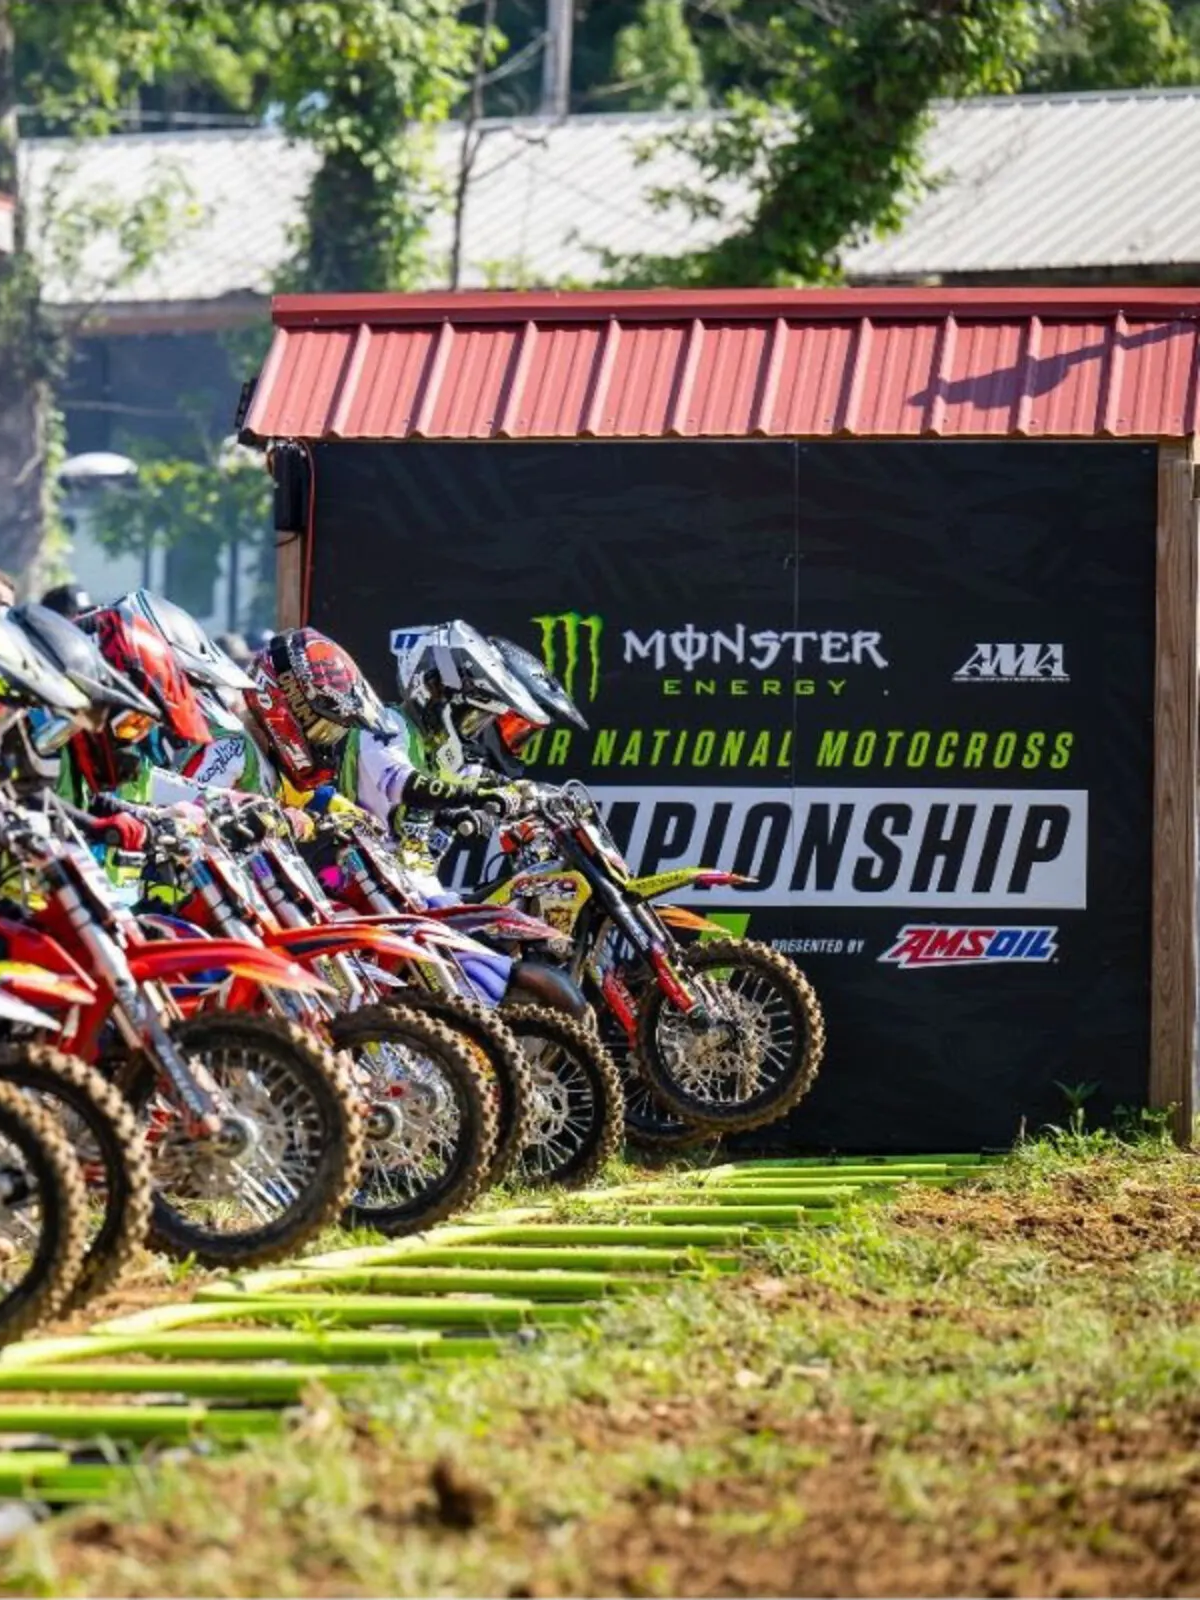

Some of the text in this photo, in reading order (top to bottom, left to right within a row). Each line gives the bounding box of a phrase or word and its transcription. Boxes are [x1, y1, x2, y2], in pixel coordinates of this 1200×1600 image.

[623, 623, 889, 671] MONSTER
[953, 643, 1070, 677] AMA
[663, 679, 847, 695] ENERGY
[591, 729, 794, 767] NATIONAL
[816, 731, 1075, 769] MOTOCROSS
[771, 938, 865, 954] PRESENTED BY
[887, 928, 1057, 960] AMSOIL
